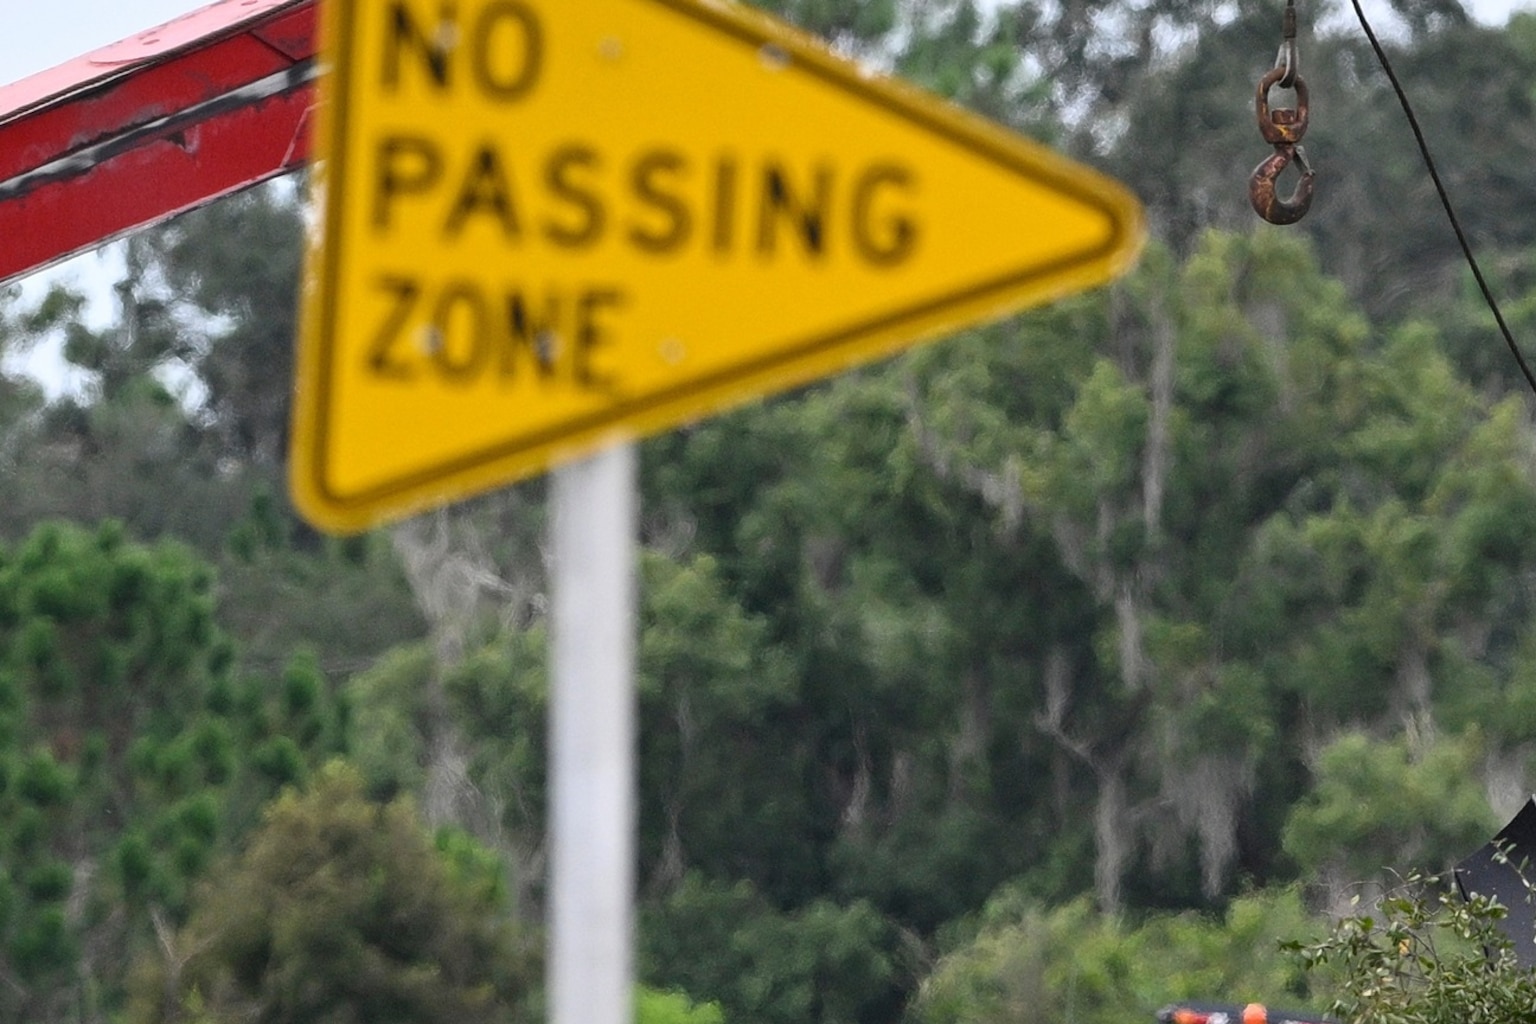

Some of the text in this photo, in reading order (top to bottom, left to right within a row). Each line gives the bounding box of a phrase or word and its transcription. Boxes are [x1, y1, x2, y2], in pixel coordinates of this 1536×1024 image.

[379, 0, 546, 102] NO
[371, 134, 920, 268] PASSING
[369, 274, 627, 391] ZONE
